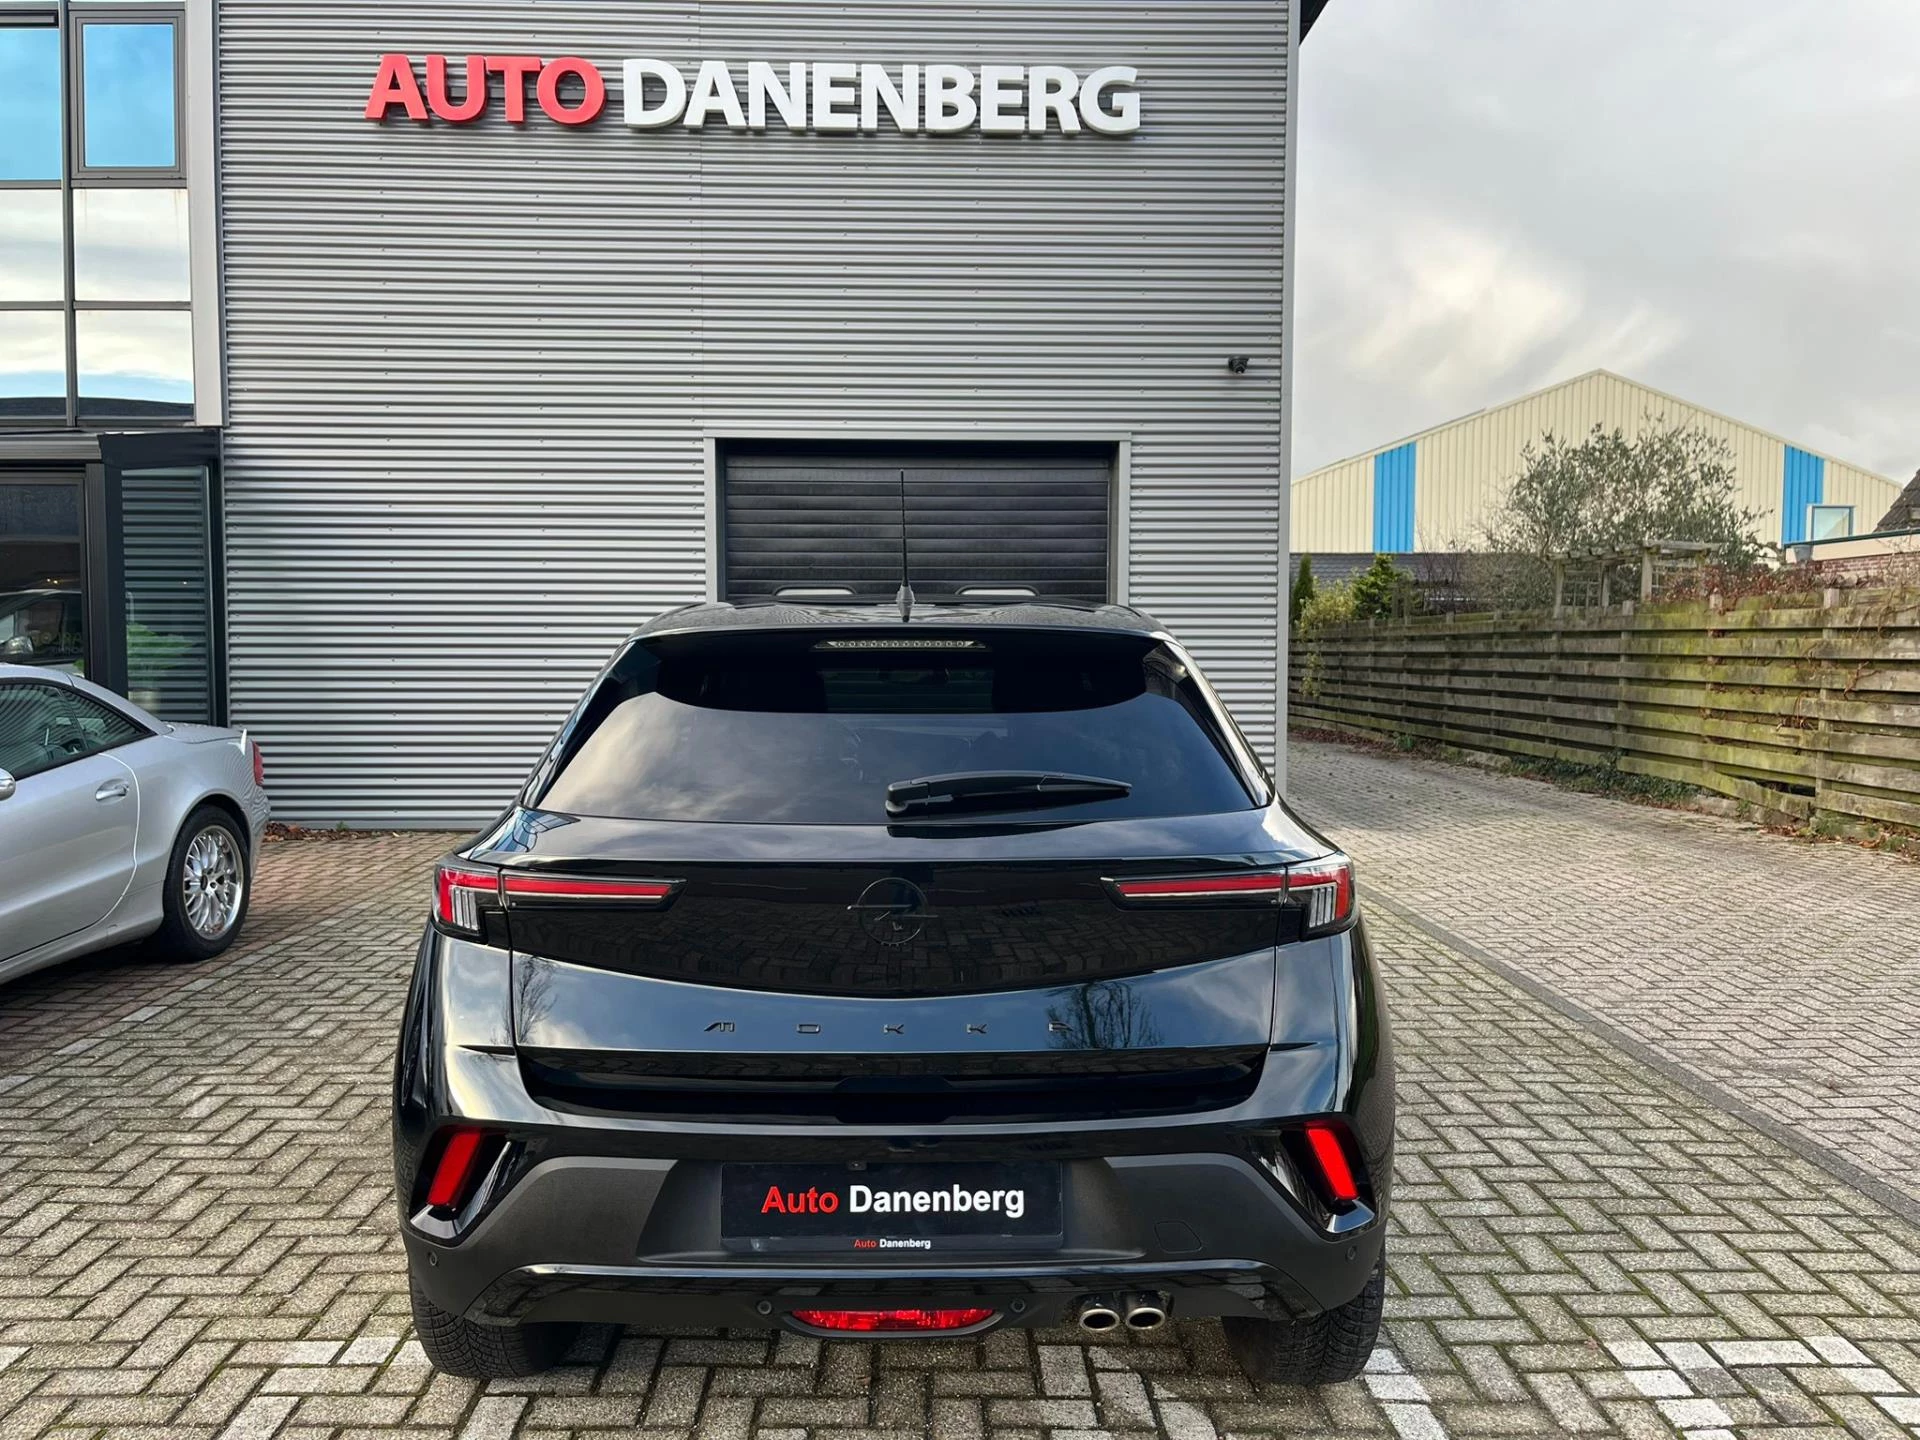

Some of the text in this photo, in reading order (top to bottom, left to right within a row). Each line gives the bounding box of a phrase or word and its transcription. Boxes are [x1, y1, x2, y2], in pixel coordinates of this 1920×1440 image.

[365, 54, 1142, 135] AUTO DANENBERG
[761, 1184, 1025, 1219] Auto Danenberg
[854, 1238, 931, 1250] Auto Danenberg
